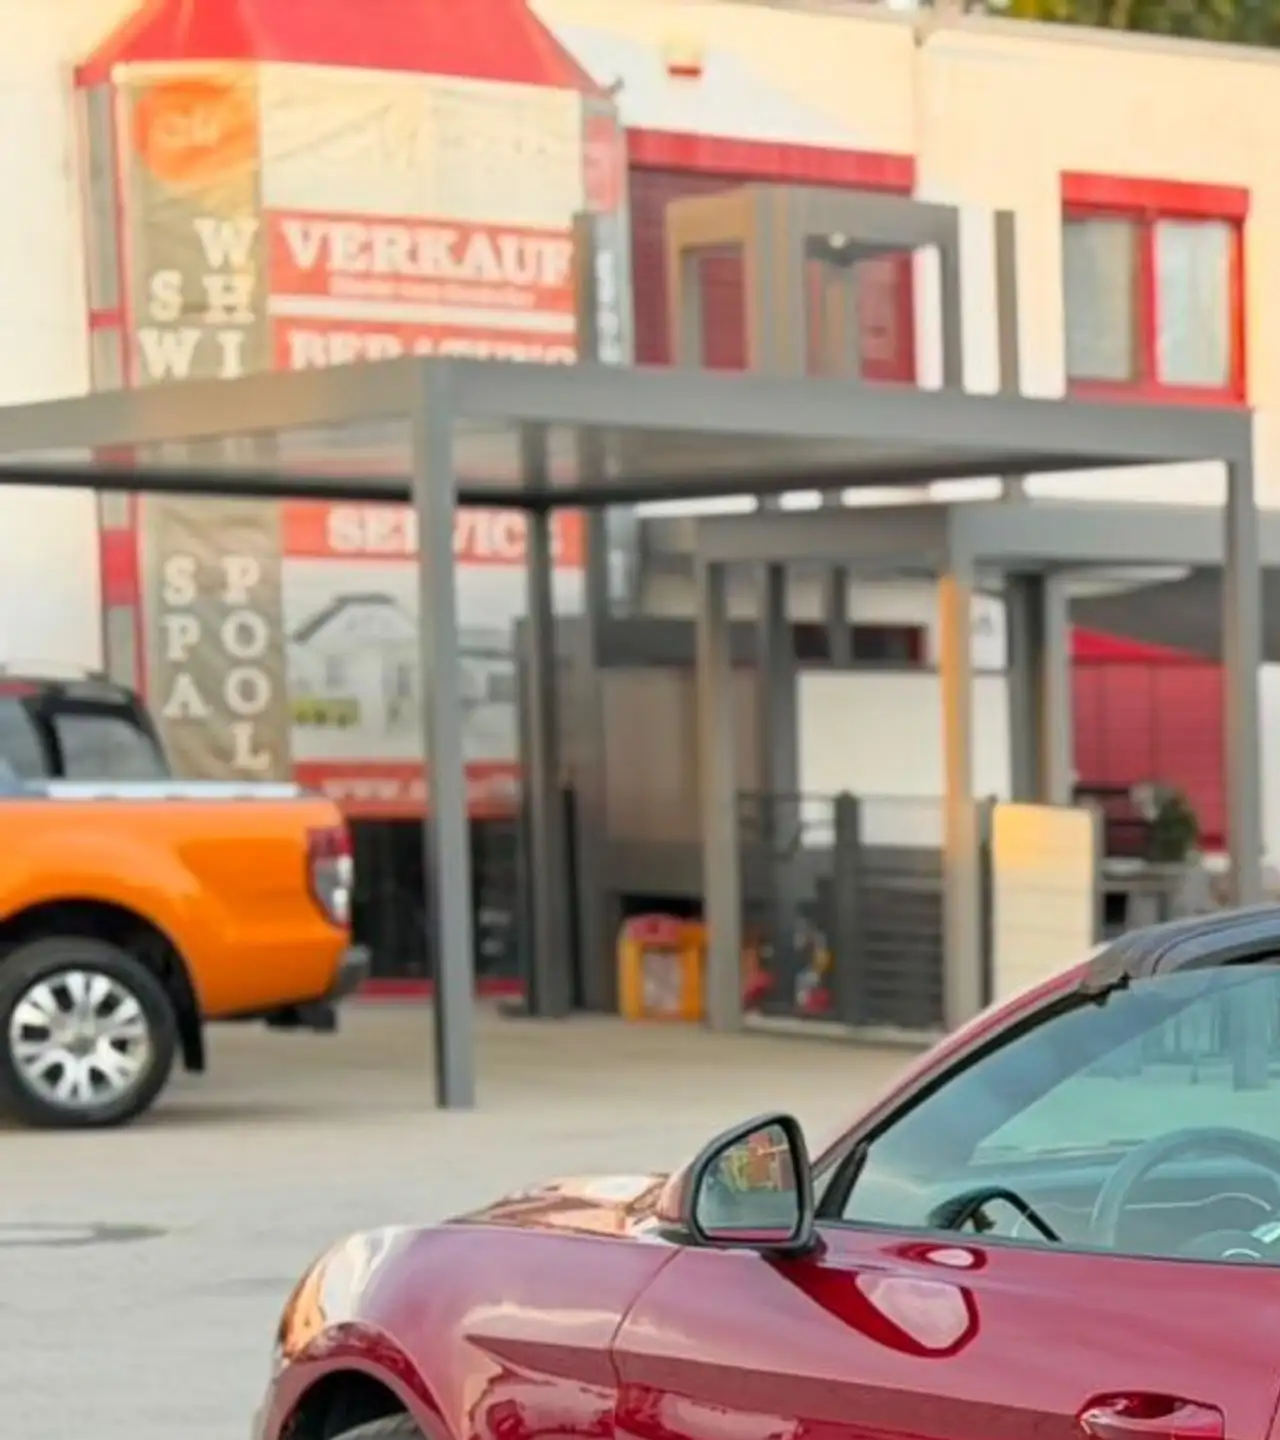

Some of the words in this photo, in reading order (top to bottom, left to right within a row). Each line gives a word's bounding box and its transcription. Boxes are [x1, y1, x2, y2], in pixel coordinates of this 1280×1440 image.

[280, 219, 573, 287] VERKAUF
[328, 504, 563, 559] SEVIC
[163, 556, 212, 719] SPA
[220, 556, 272, 770] POOL
